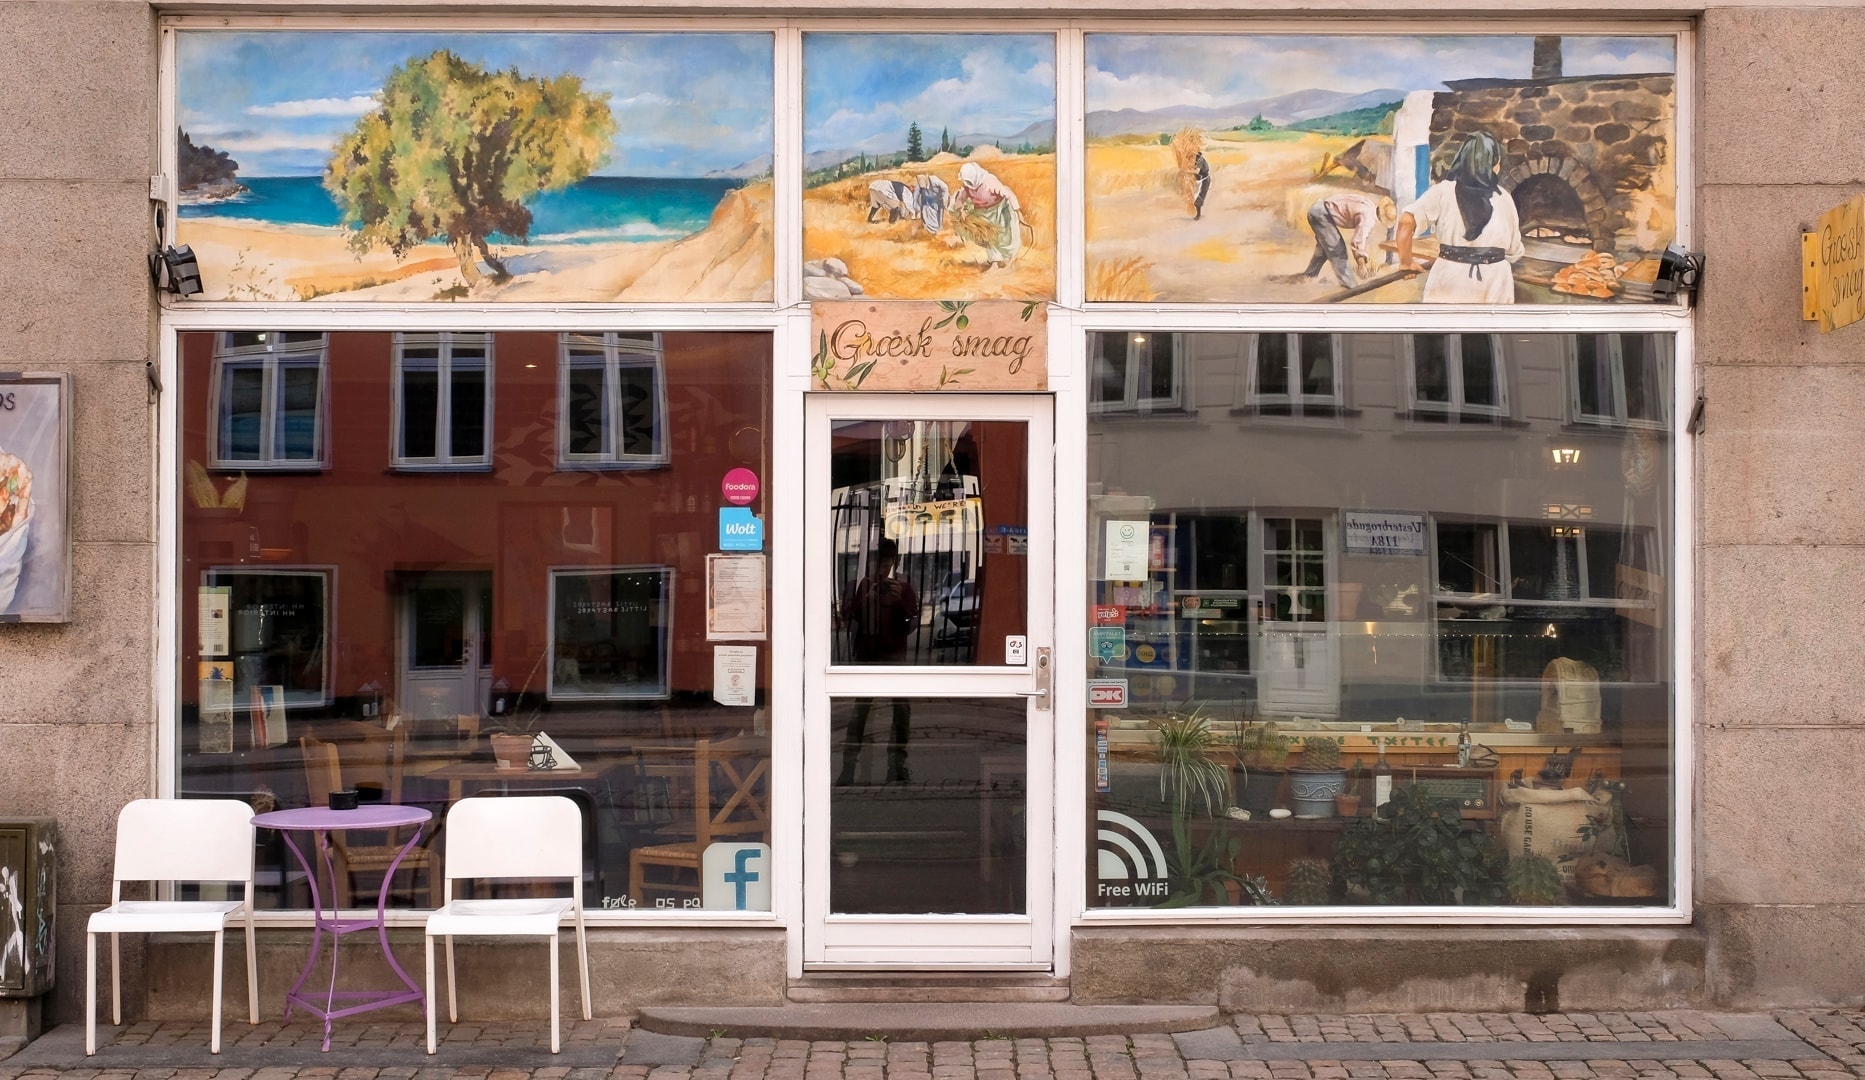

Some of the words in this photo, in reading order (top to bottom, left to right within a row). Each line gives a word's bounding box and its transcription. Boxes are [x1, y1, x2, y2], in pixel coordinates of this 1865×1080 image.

[830, 315, 934, 368] Græsk
[952, 334, 1034, 375] smag
[725, 482, 756, 491] foodora
[726, 523, 756, 535] Wolt
[1091, 690, 1122, 700] DK
[1098, 883, 1131, 897] Free
[1134, 882, 1169, 896] WiFi
